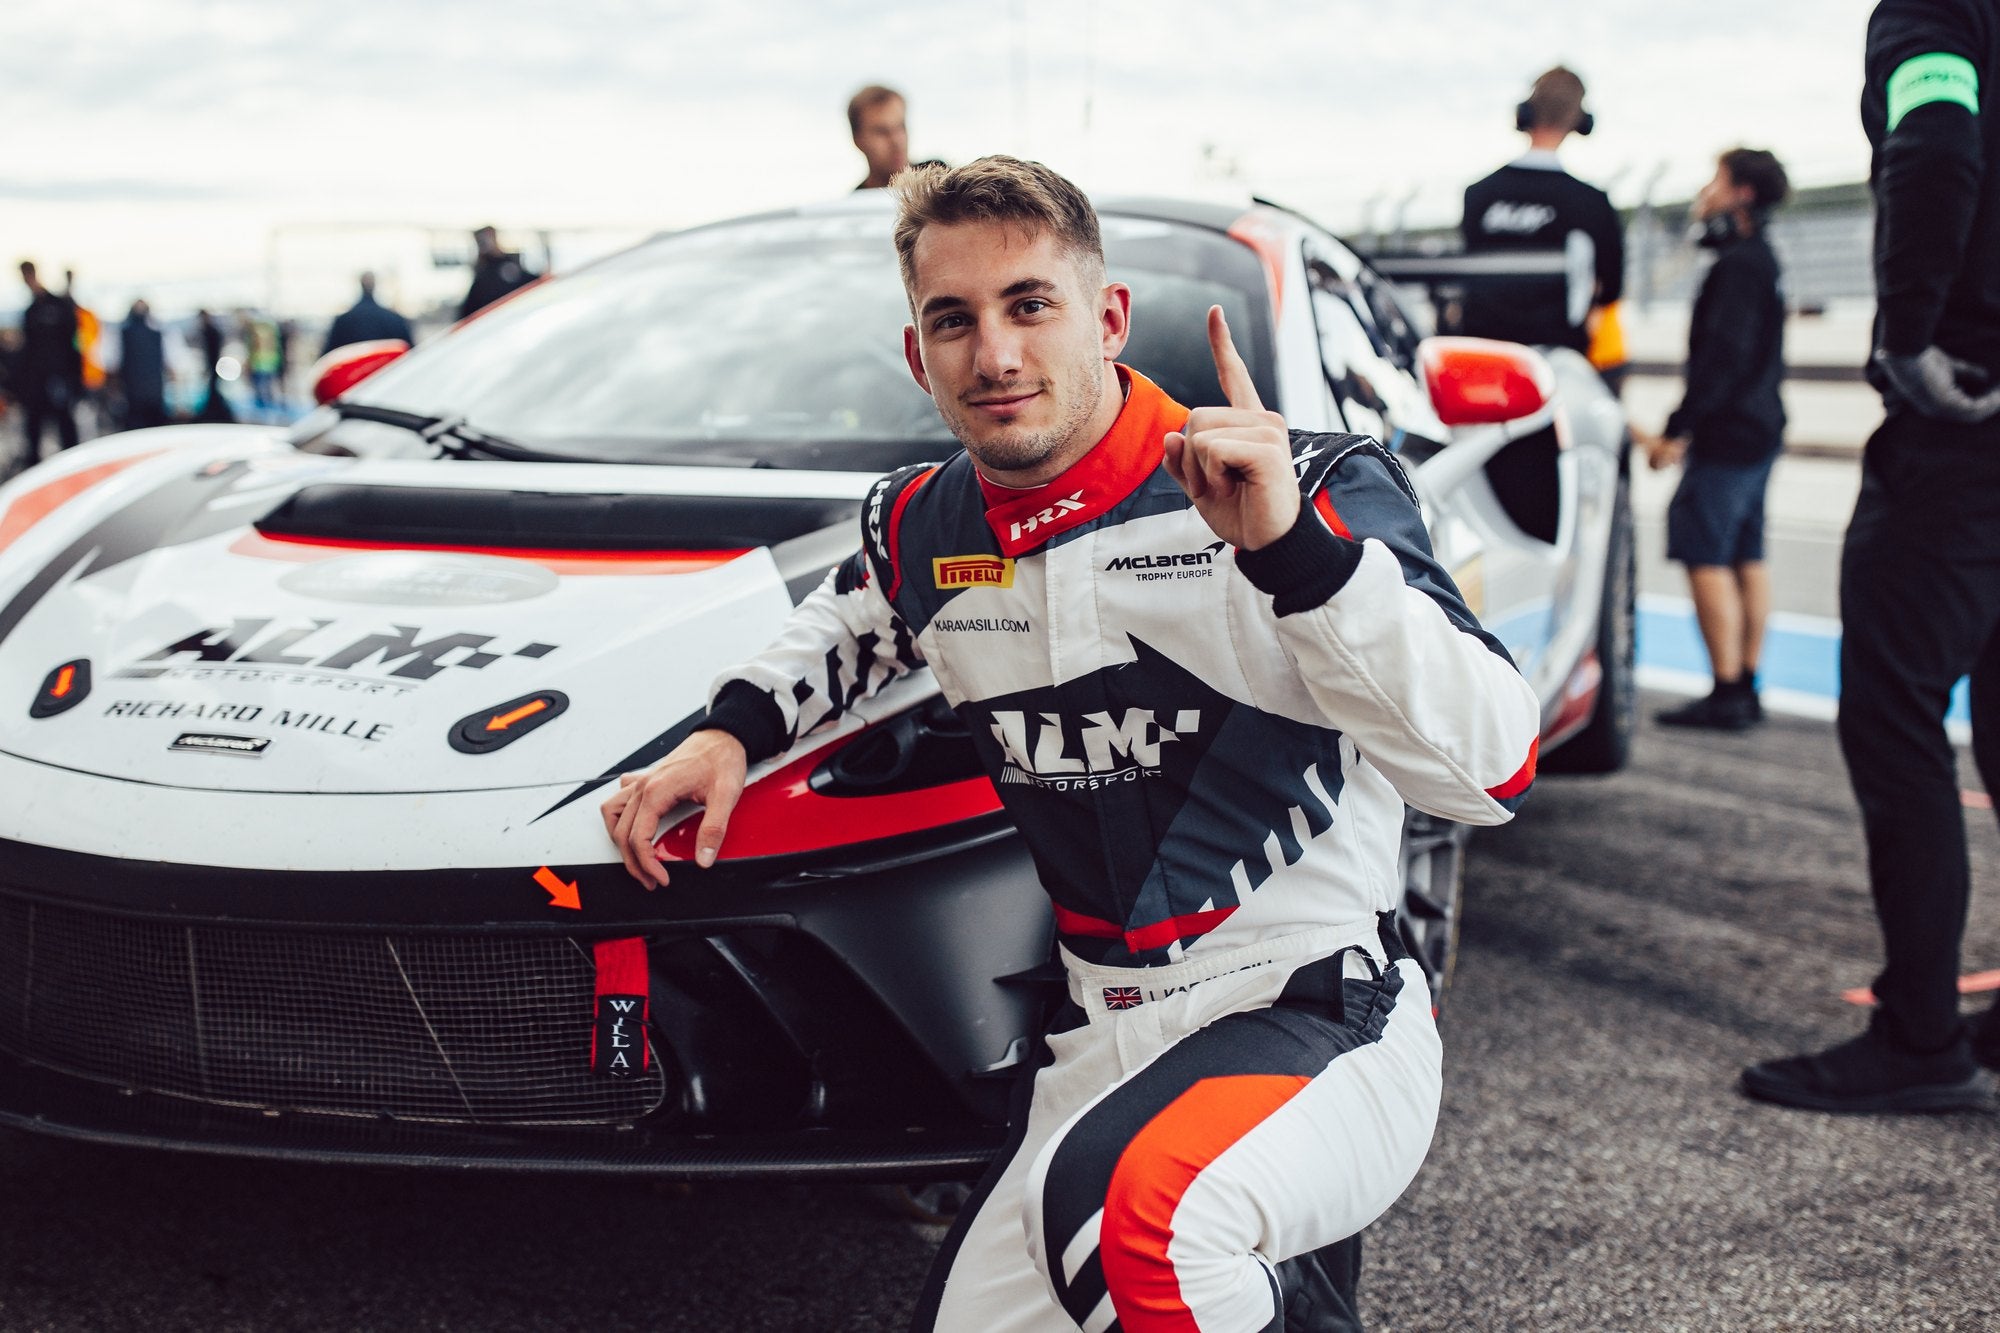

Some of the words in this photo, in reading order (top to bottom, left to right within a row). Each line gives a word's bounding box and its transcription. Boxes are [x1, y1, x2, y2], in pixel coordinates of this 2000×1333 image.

[1010, 489, 1086, 541] HRX
[940, 560, 1005, 584] PIRELLI
[1105, 550, 1213, 571] McLaren
[1136, 572, 1174, 581] TROPHY
[1177, 569, 1213, 580] EUROPE
[934, 618, 1030, 633] KARAVASILI.COM
[137, 618, 503, 680] ALM
[104, 699, 263, 722] RICHARD
[271, 710, 393, 742] MILLE
[990, 707, 1165, 774] ALM
[609, 1000, 636, 1077] WILLA
